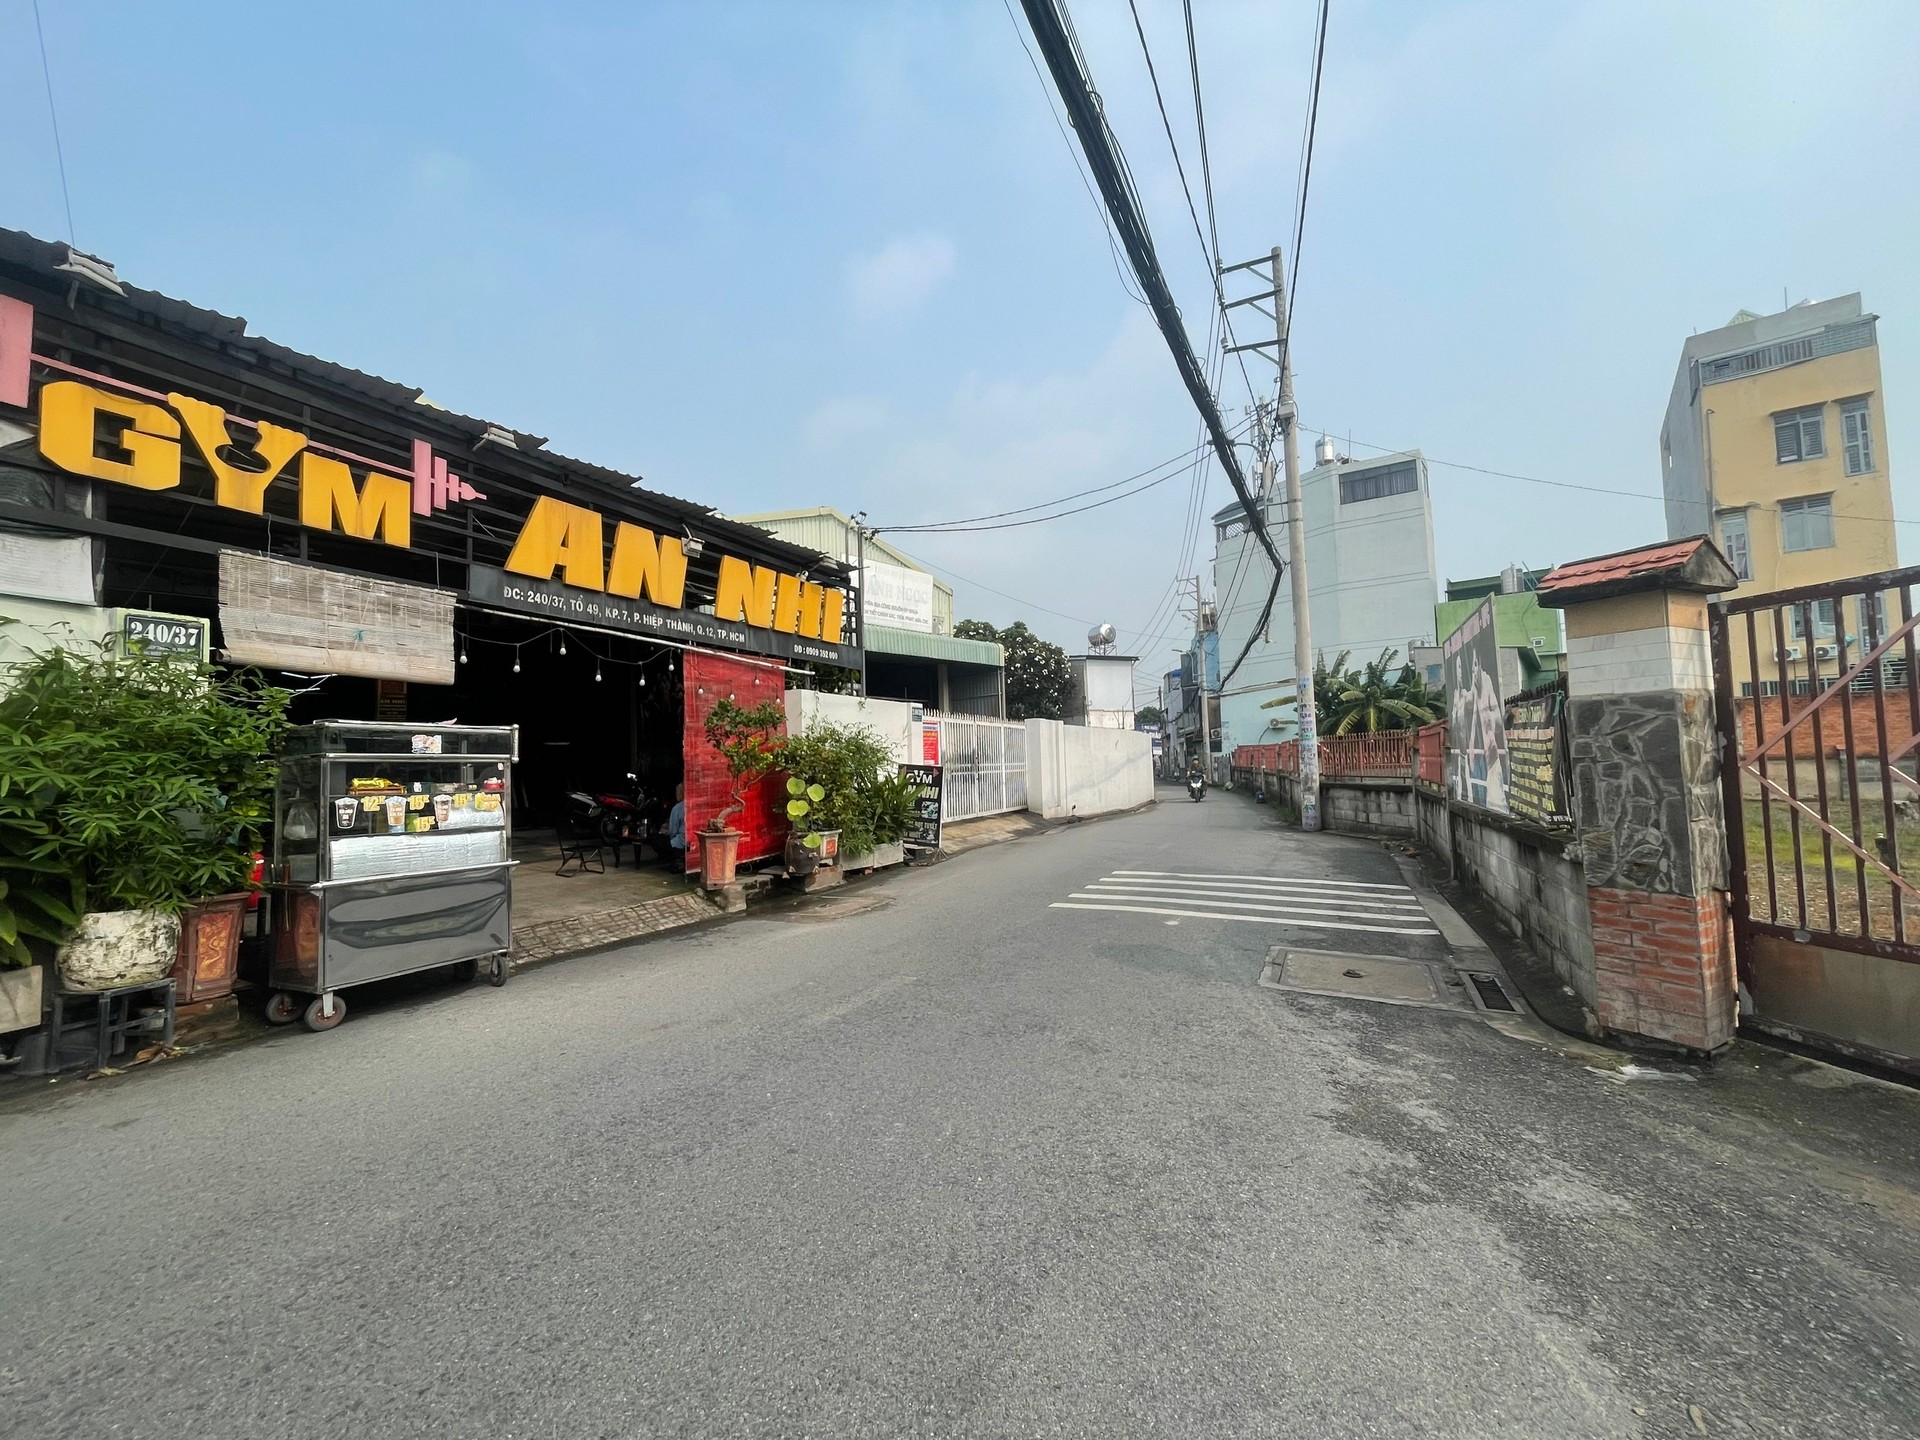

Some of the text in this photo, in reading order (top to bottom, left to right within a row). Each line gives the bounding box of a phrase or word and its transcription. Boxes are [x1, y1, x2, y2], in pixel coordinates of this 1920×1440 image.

[40, 381, 411, 549] GYM
[504, 495, 844, 645] AN NHI
[130, 621, 199, 646] 240/37
[504, 586, 524, 600] ĐC:
[527, 590, 566, 611] 240/37,
[570, 594, 583, 612] TỔ
[587, 603, 601, 618] 49,
[643, 613, 663, 629] HIỆP
[666, 618, 695, 635] THÀNH,
[717, 628, 728, 639] TP.
[729, 631, 745, 642] HCM
[806, 646, 819, 657] 0909
